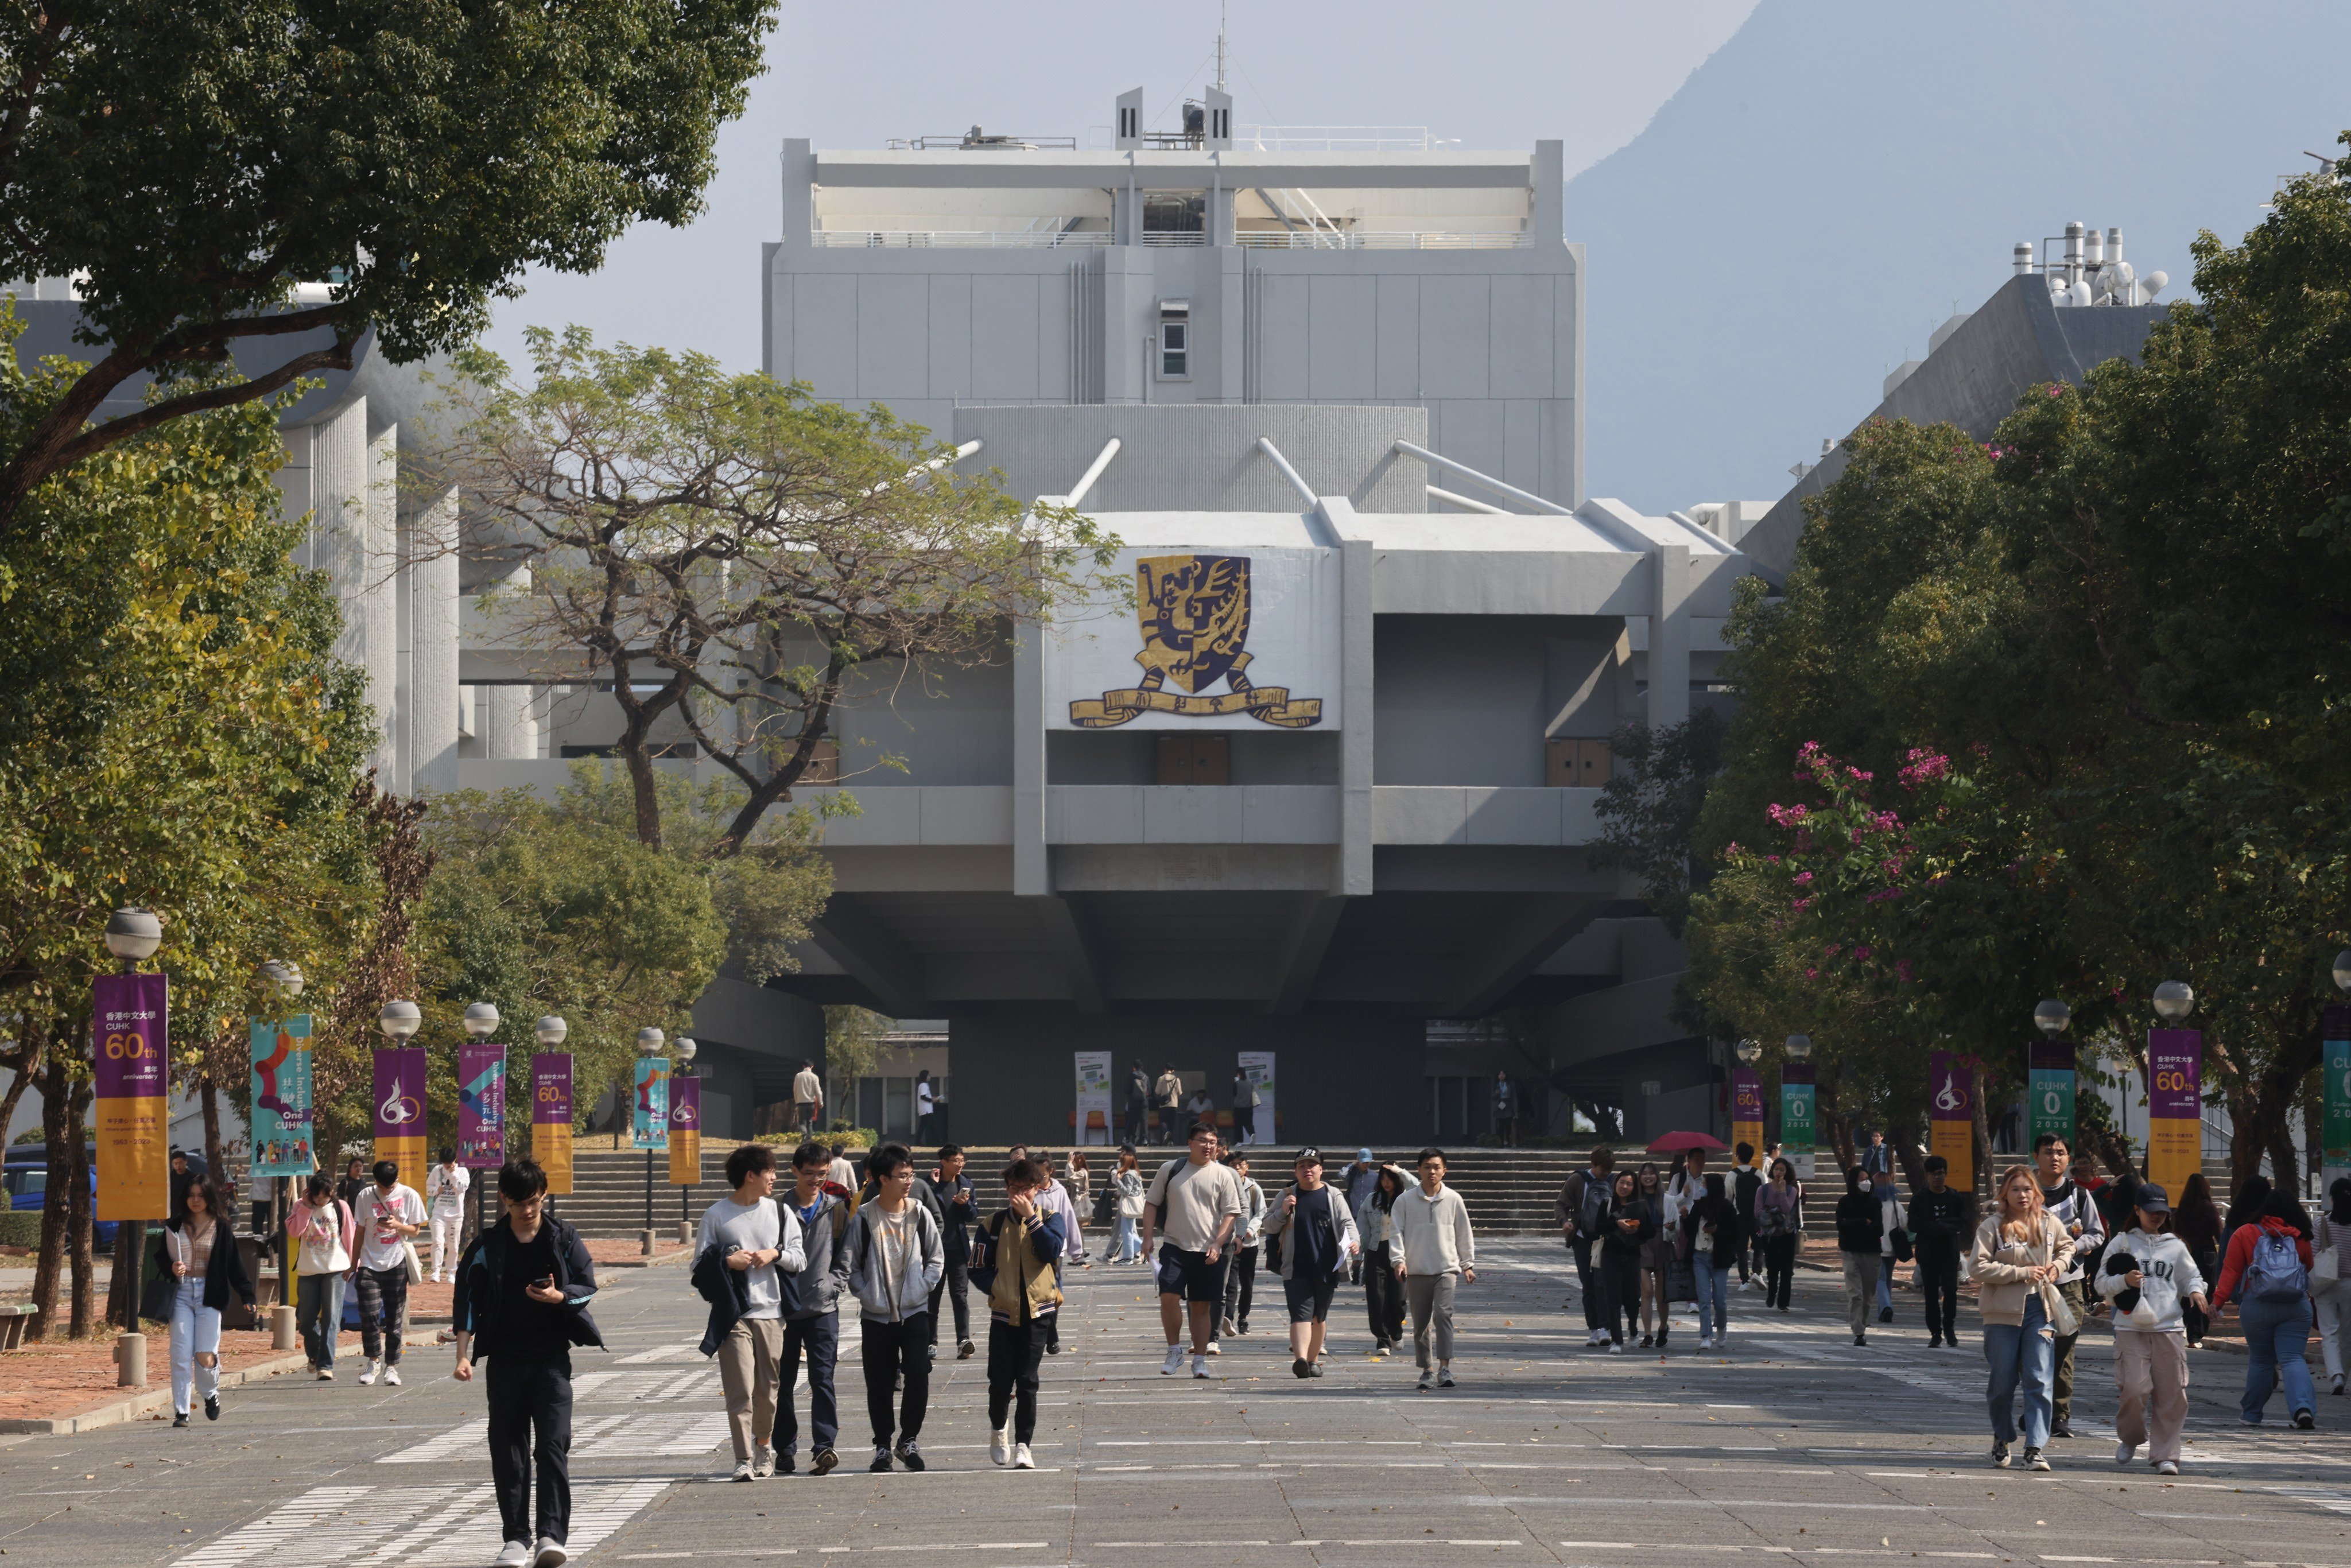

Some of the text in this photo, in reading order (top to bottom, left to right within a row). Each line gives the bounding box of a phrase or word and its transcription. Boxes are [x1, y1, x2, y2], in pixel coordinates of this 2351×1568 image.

[106, 1011, 156, 1021] 香港中文大學
[106, 1022, 130, 1030] CUHK
[106, 1033, 158, 1059] 60th
[2036, 1081, 2067, 1090] CUHK
[2156, 1071, 2194, 1091] 60th
[538, 1086, 567, 1102] 60th
[282, 1111, 304, 1120] One
[275, 1121, 303, 1130] CUHK
